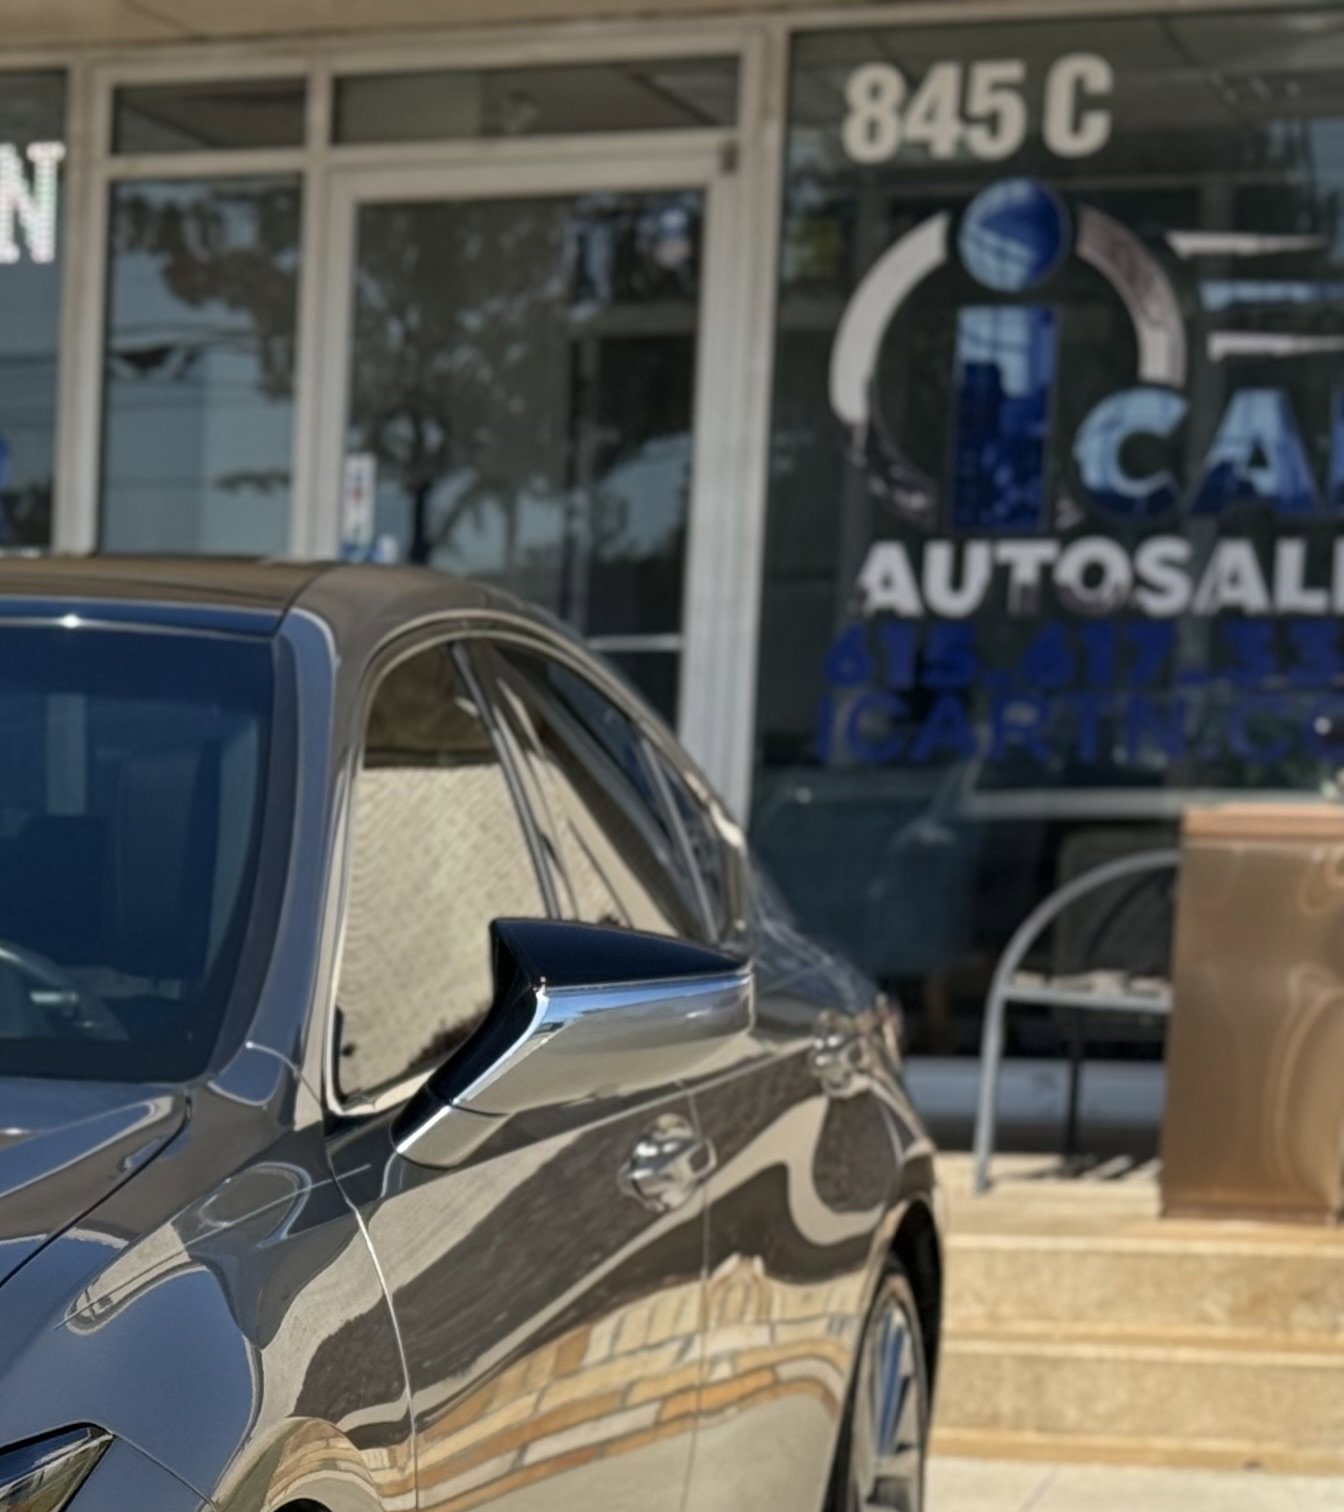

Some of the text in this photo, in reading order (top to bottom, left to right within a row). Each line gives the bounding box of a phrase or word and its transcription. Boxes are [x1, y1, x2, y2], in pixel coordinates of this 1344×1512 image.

[842, 52, 1113, 164] 845 C
[1073, 387, 1344, 516] CA
[858, 535, 1344, 618] AUTOSAL
